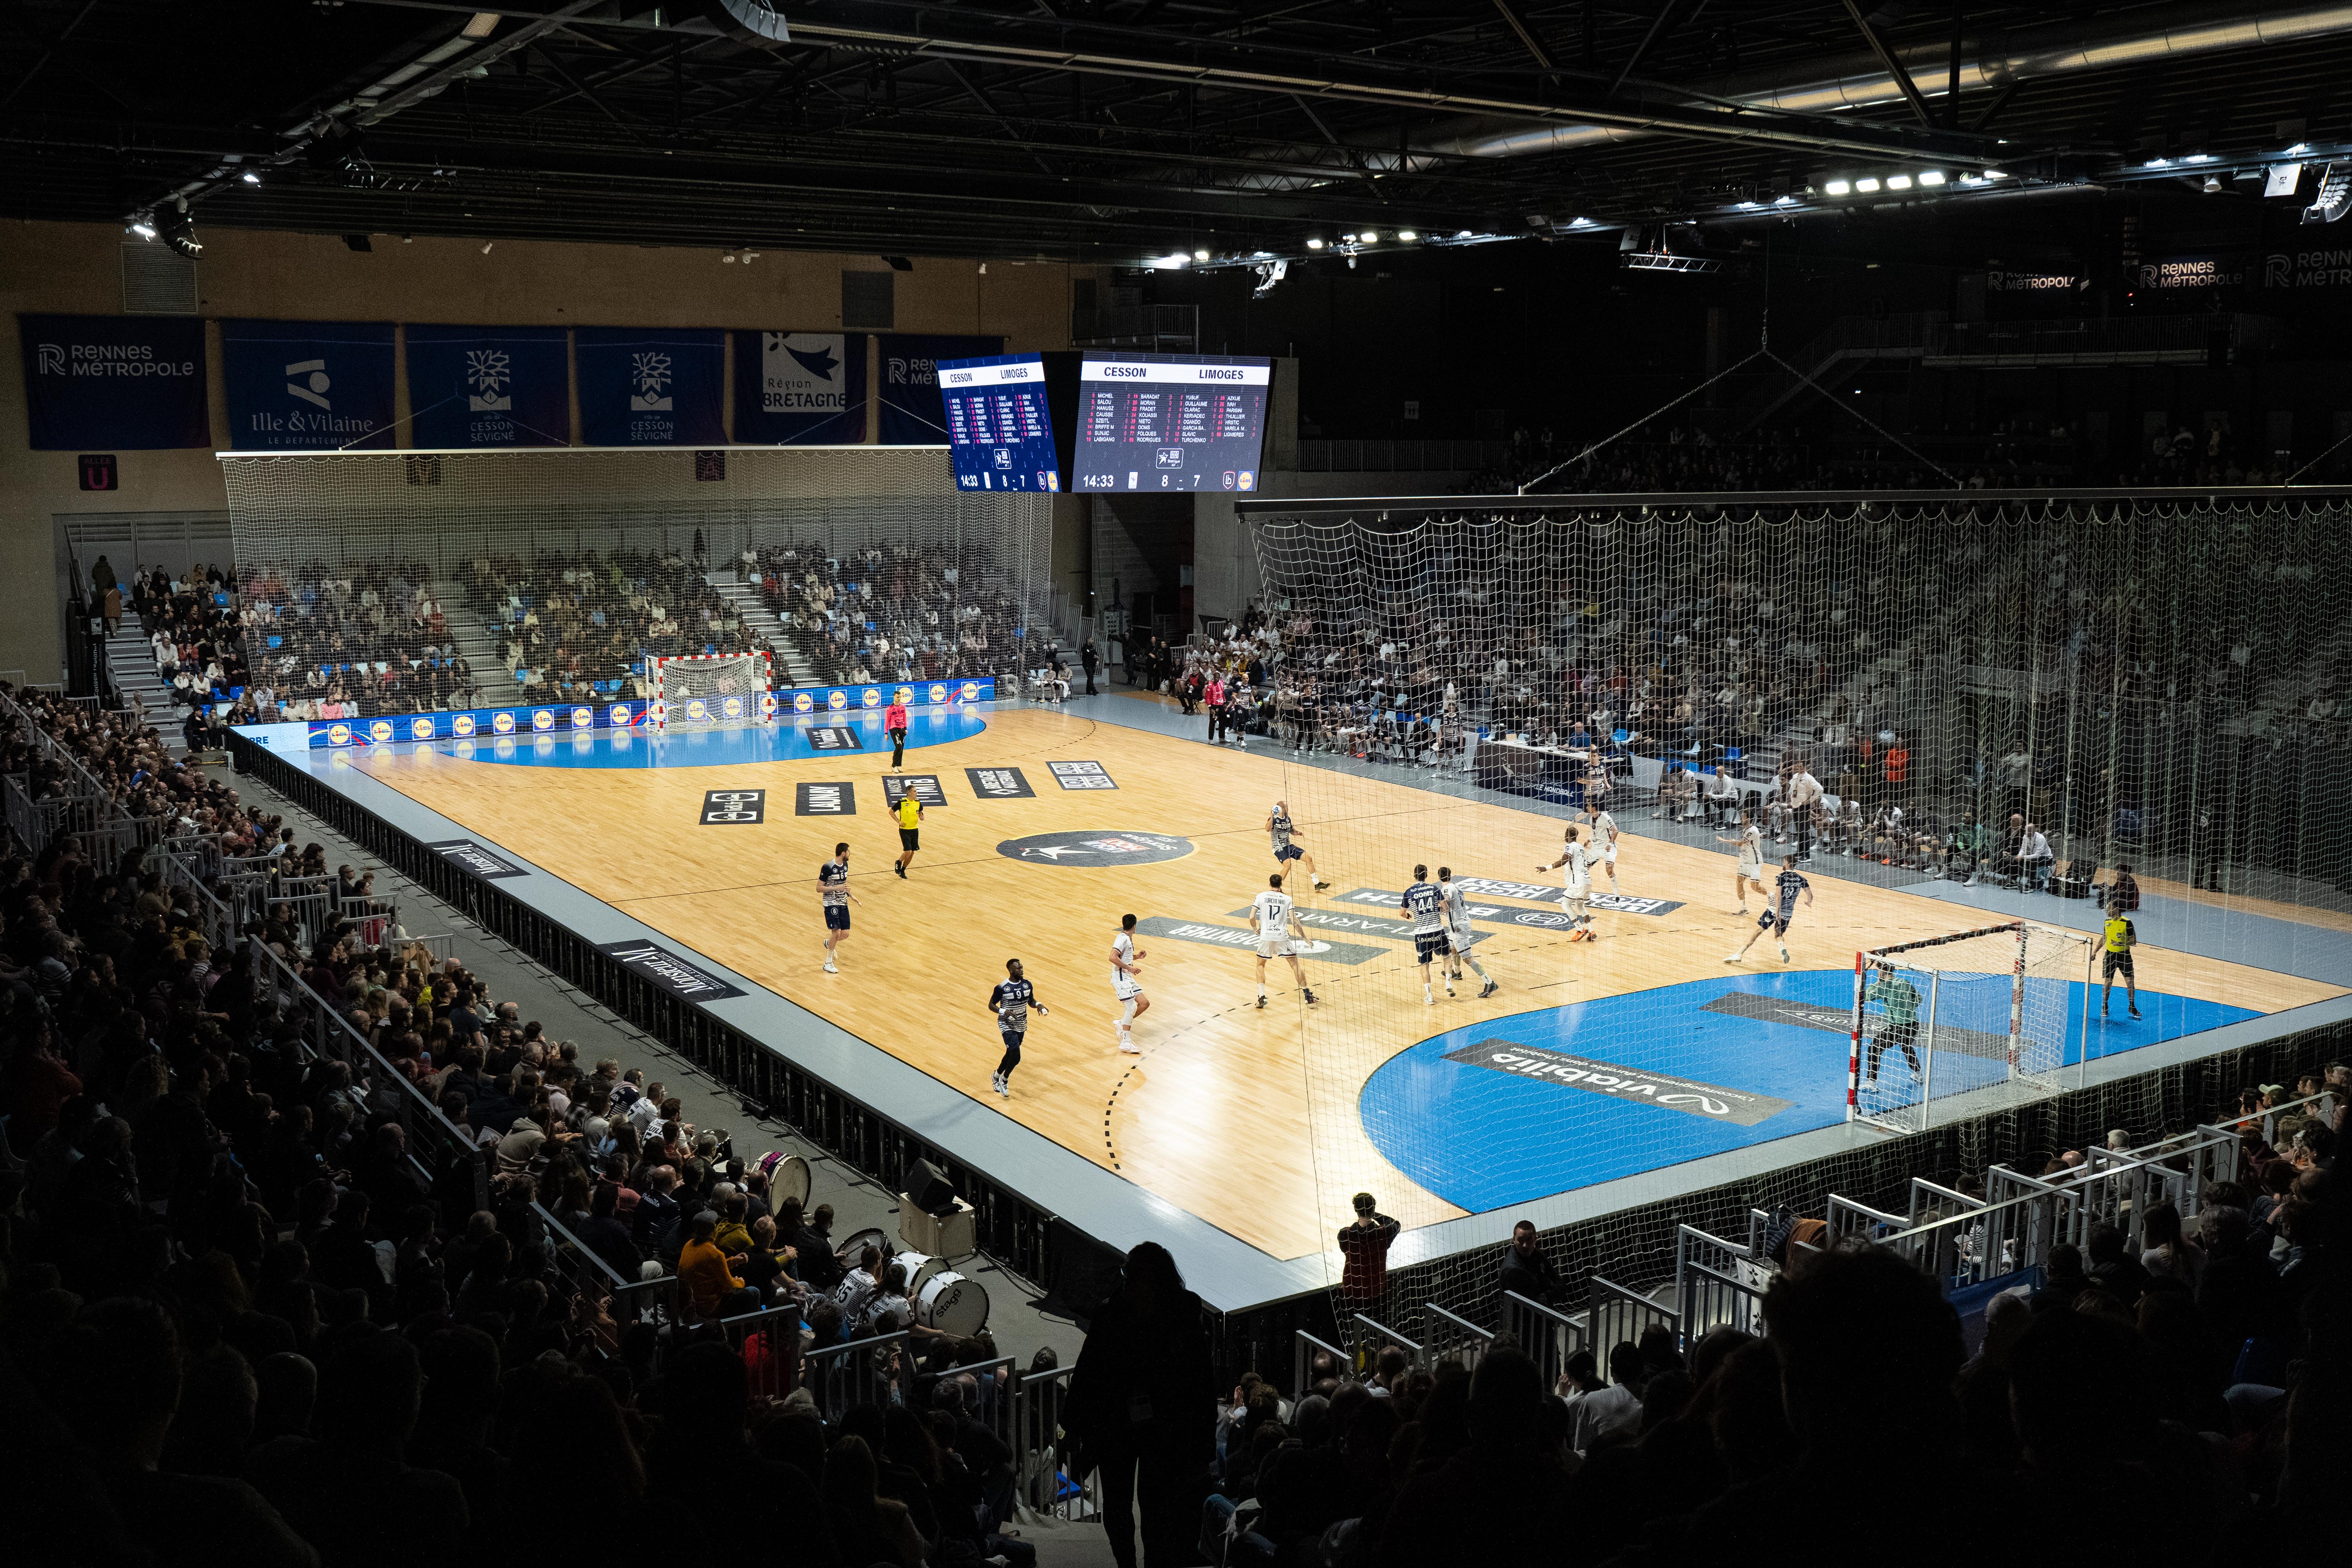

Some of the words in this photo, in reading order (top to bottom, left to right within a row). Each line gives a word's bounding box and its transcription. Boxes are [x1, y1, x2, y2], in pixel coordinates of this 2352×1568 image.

[950, 373, 973, 383] CESSON
[1000, 368, 1028, 379] LIMOGES
[1104, 367, 1147, 378] CESSON
[1199, 368, 1244, 380] LIMOGES
[768, 378, 811, 390] Région
[289, 411, 305, 432] &
[308, 414, 373, 432] Vilaine
[470, 421, 513, 431] CESSON
[631, 421, 673, 430] CESSON
[87, 467, 109, 490] U
[961, 475, 978, 486] 14:33
[1002, 475, 1007, 487] 8
[1020, 475, 1024, 487] 7
[1083, 475, 1114, 487] 14:33
[1161, 475, 1168, 487] 8
[1194, 475, 1200, 487] 7
[977, 770, 1002, 789] BRETAGNE
[809, 786, 841, 811] LAUNAY
[1414, 890, 1434, 899] OOMS
[1418, 897, 1434, 913] 44
[1269, 905, 1280, 920] 17
[1016, 990, 1022, 999] 9
[936, 1288, 962, 1318] Stagg
